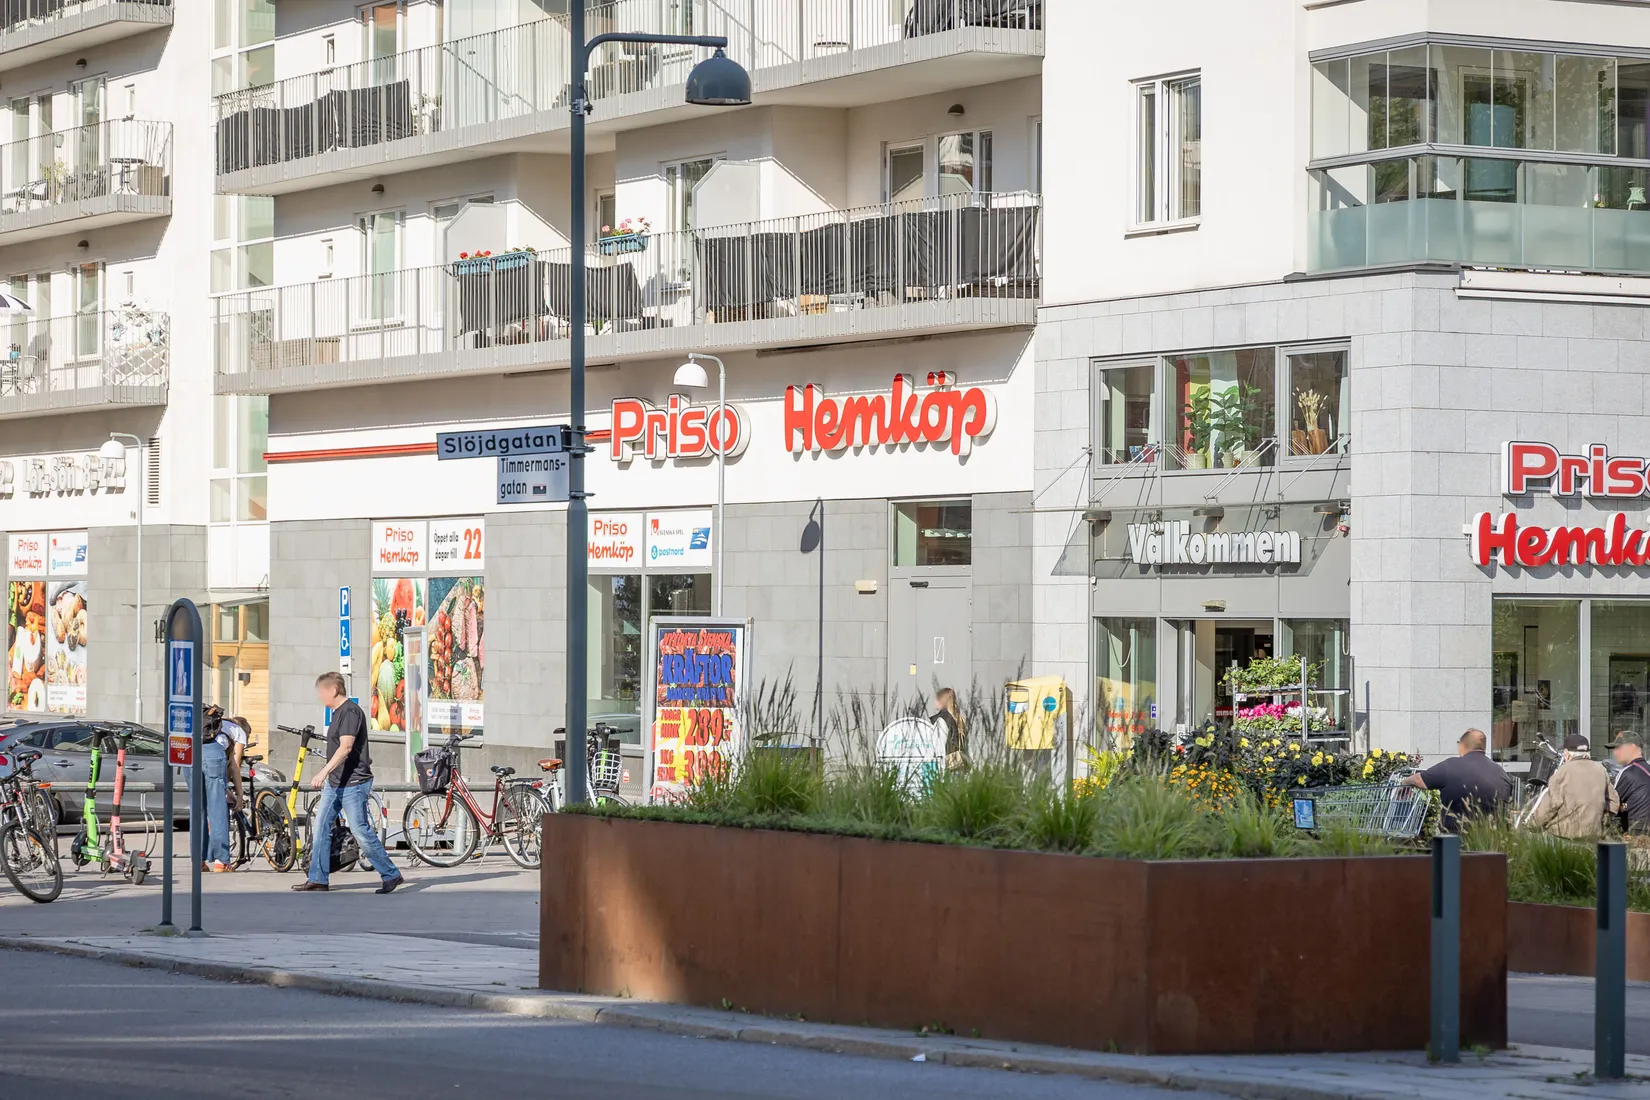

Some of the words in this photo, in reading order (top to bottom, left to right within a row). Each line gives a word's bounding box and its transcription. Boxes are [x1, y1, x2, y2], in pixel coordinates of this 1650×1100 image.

[784, 370, 987, 456] Hemköp
[610, 393, 741, 461] Priso
[444, 432, 556, 455] Slöjdgatan
[501, 458, 566, 473] Timmermans-
[1507, 440, 1650, 497] Pris
[500, 479, 527, 499] gatan
[385, 527, 414, 542] Priso
[434, 528, 448, 545] Öppet
[449, 530, 459, 542] alla
[593, 519, 628, 535] Priso
[18, 538, 39, 552] Priso
[463, 527, 482, 560] 22
[1127, 519, 1300, 565] Välkommen
[1478, 512, 1650, 567] Hemk
[380, 546, 419, 566] Hemköp
[435, 548, 449, 561] dagar
[450, 547, 458, 559] till
[588, 541, 634, 562] Hemköp
[659, 547, 684, 557] postnord
[14, 555, 42, 571] Hemköp
[341, 589, 349, 615] P
[662, 648, 733, 684] KRÄFTOR
[685, 708, 724, 747] 289
